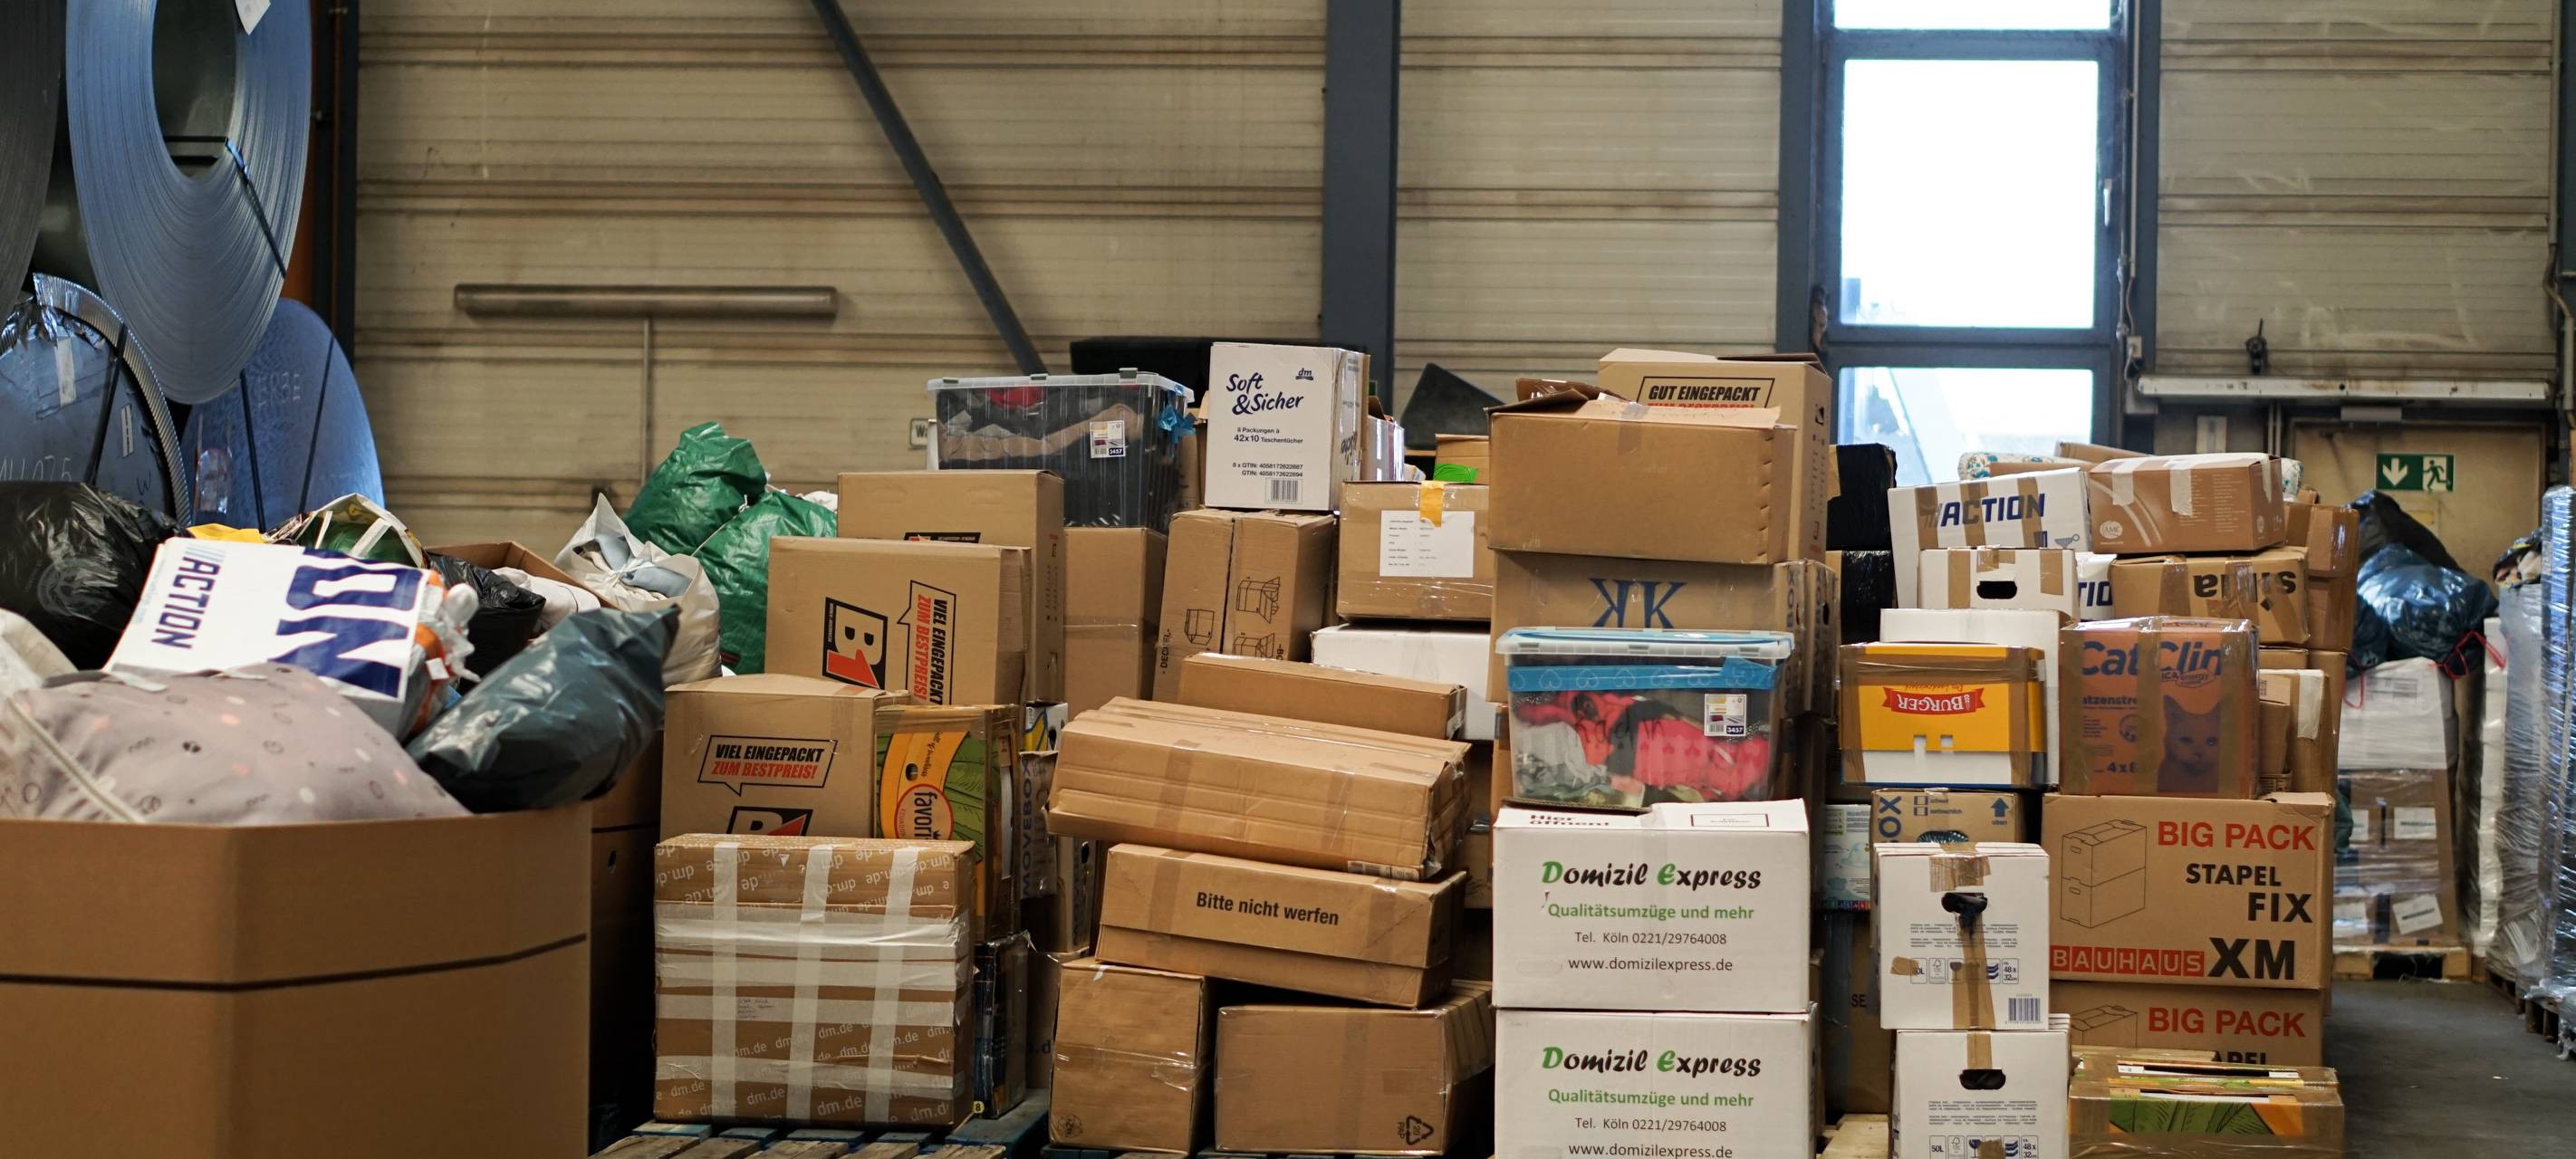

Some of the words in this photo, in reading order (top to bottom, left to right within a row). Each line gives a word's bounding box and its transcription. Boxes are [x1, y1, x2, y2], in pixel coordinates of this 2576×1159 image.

[1298, 368, 1312, 378] dm
[1226, 372, 1264, 394] Soft
[1648, 385, 1677, 400] GUT
[1677, 386, 1761, 402] EINGEPACKT
[1941, 493, 2045, 527] ACTION
[151, 557, 221, 649] ACTION
[916, 594, 931, 627] ZUM
[933, 599, 947, 625] VIEL
[913, 627, 929, 702] BESTPREIS!
[930, 627, 947, 705] EINGEPACKT
[1897, 694, 1964, 712] BURGER
[716, 744, 741, 759] VIEL
[744, 746, 825, 762] EINGEPACKT
[711, 761, 740, 776] ZUM
[742, 762, 818, 779] BESTPREIS!
[1879, 796, 1902, 842] OX
[2158, 820, 2214, 848] BIG
[2225, 823, 2315, 850] PACK
[1542, 860, 1648, 887] Domizil
[1657, 863, 1762, 891] Express
[2186, 863, 2282, 886] STAPEL
[1197, 892, 1234, 911] Bitte
[1238, 898, 1279, 917] nicht
[1283, 906, 1339, 925] werfen
[1548, 904, 1676, 921] Qualitätsumzüge
[1681, 905, 1709, 919] und
[1714, 906, 1754, 920] mehr
[2248, 892, 2313, 924] FIX
[1575, 932, 1596, 943] Tel.
[1603, 932, 1629, 943] Köln
[1632, 933, 1726, 945] 0221/29764008
[1568, 957, 1734, 973] www.domizilexpress.de
[2052, 948, 2203, 974] BAUHAUS
[2207, 937, 2295, 981] XM
[2004, 965, 2012, 973] 48
[818, 1023, 853, 1039] dm.de
[2148, 1007, 2205, 1034] BIG
[2216, 1011, 2305, 1038] PACK
[735, 1042, 768, 1058] dm.de
[1542, 1047, 1648, 1074] Domizil
[1657, 1049, 1762, 1078] Express
[671, 1081, 706, 1097] dm.de
[747, 1087, 785, 1106] dm.de
[1548, 1089, 1676, 1107] Qualitätsumzüge
[1681, 1092, 1709, 1106] und
[1714, 1092, 1754, 1106] mehr
[817, 1096, 862, 1116] dm.de
[976, 1102, 982, 1113] 8
[1575, 1117, 1596, 1128] Tel.
[1603, 1117, 1629, 1129] Köln
[1632, 1118, 1726, 1132] 0221/29764008
[1568, 1144, 1734, 1159] www.domizilexpress.de
[1931, 1145, 1944, 1153] 50L
